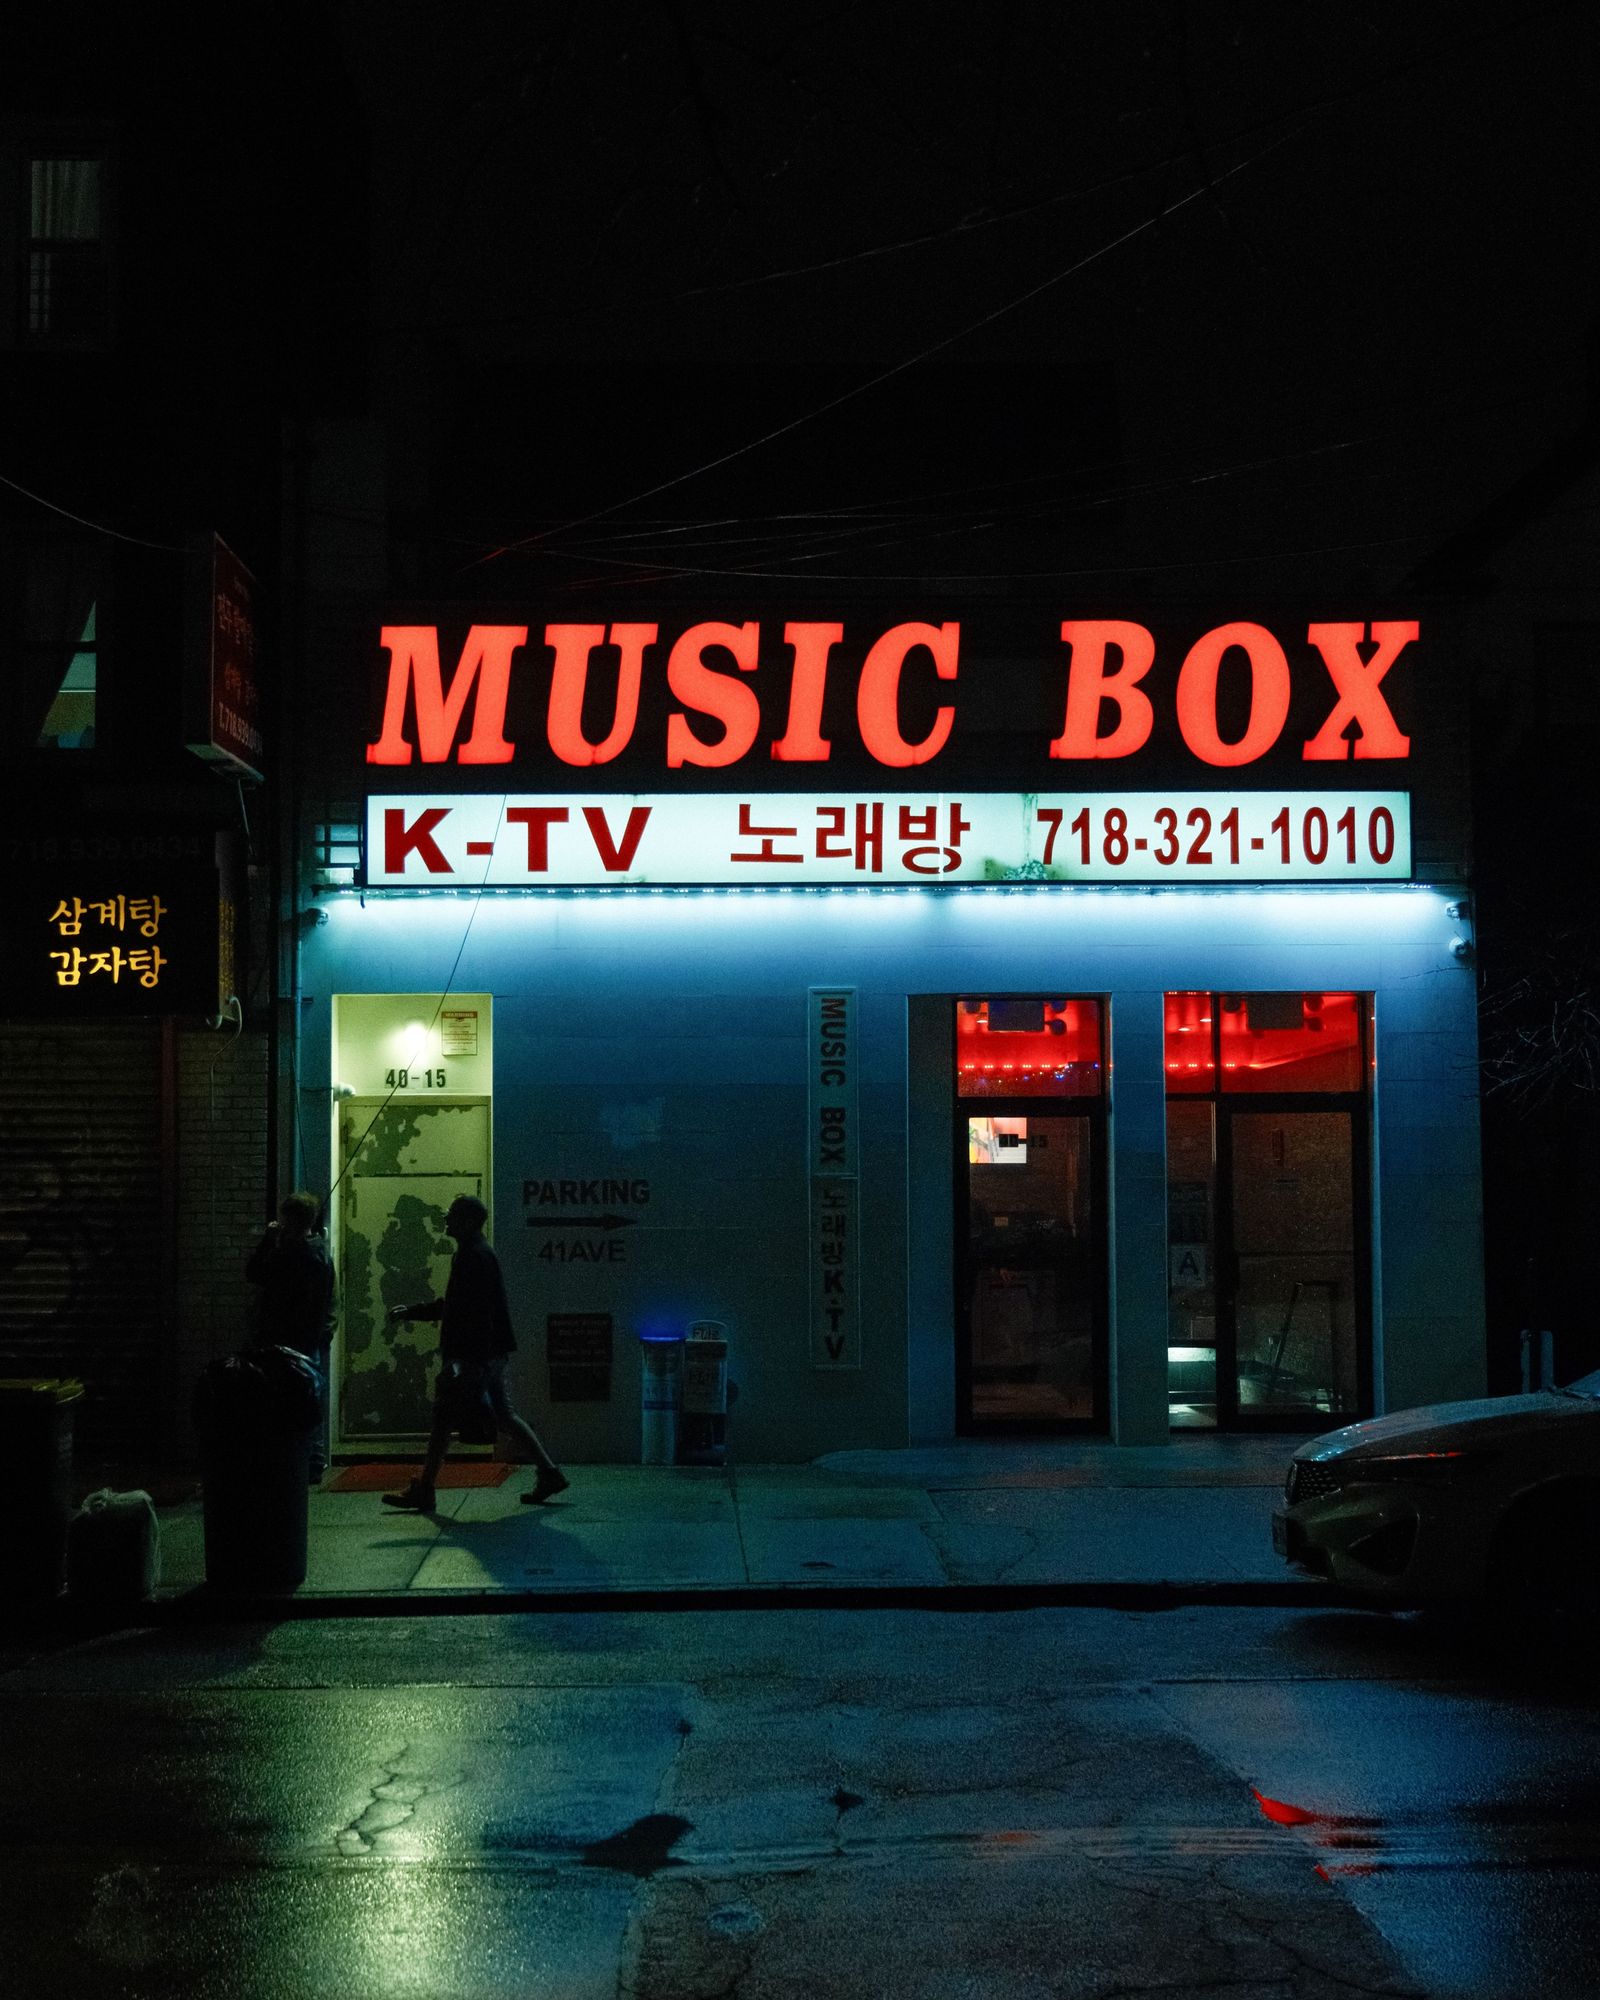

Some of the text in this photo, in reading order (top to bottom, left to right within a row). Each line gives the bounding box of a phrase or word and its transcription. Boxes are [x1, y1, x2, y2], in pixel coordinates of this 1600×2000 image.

[366, 620, 961, 768] MUSIC
[1049, 619, 1420, 768] BOX
[384, 806, 653, 874] K-TV
[730, 802, 972, 875] 노래방
[1036, 805, 1396, 866] 718-321-1010
[48, 894, 168, 938] 삼계탕
[48, 944, 168, 989] 감자탕
[385, 1068, 447, 1089] 40-15
[820, 998, 846, 1164] MUSIC BOX
[523, 1179, 650, 1204] PARKING
[1178, 1251, 1200, 1275] A
